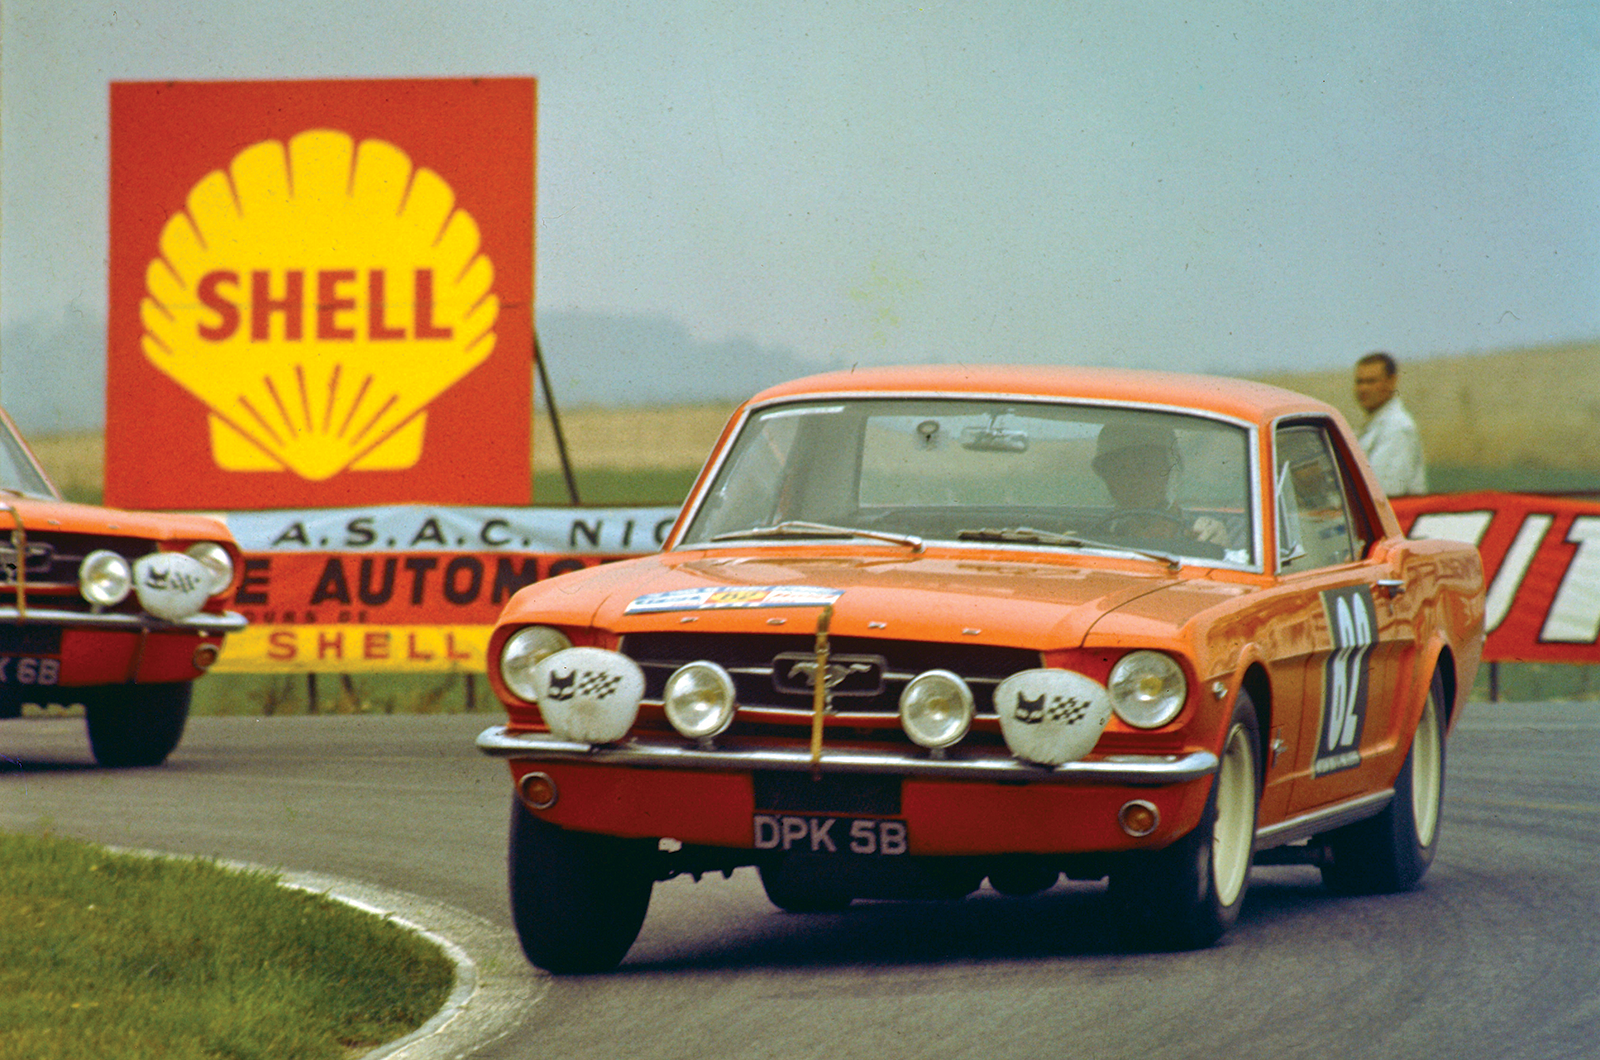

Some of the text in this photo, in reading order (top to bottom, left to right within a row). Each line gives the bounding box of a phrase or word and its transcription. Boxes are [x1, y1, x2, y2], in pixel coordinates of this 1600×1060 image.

[198, 268, 454, 342] SHELL
[271, 516, 531, 547] A.S.A.C.
[267, 631, 471, 661] SHELL
[17, 657, 60, 685] 6B
[753, 815, 907, 855] DPK 5B
